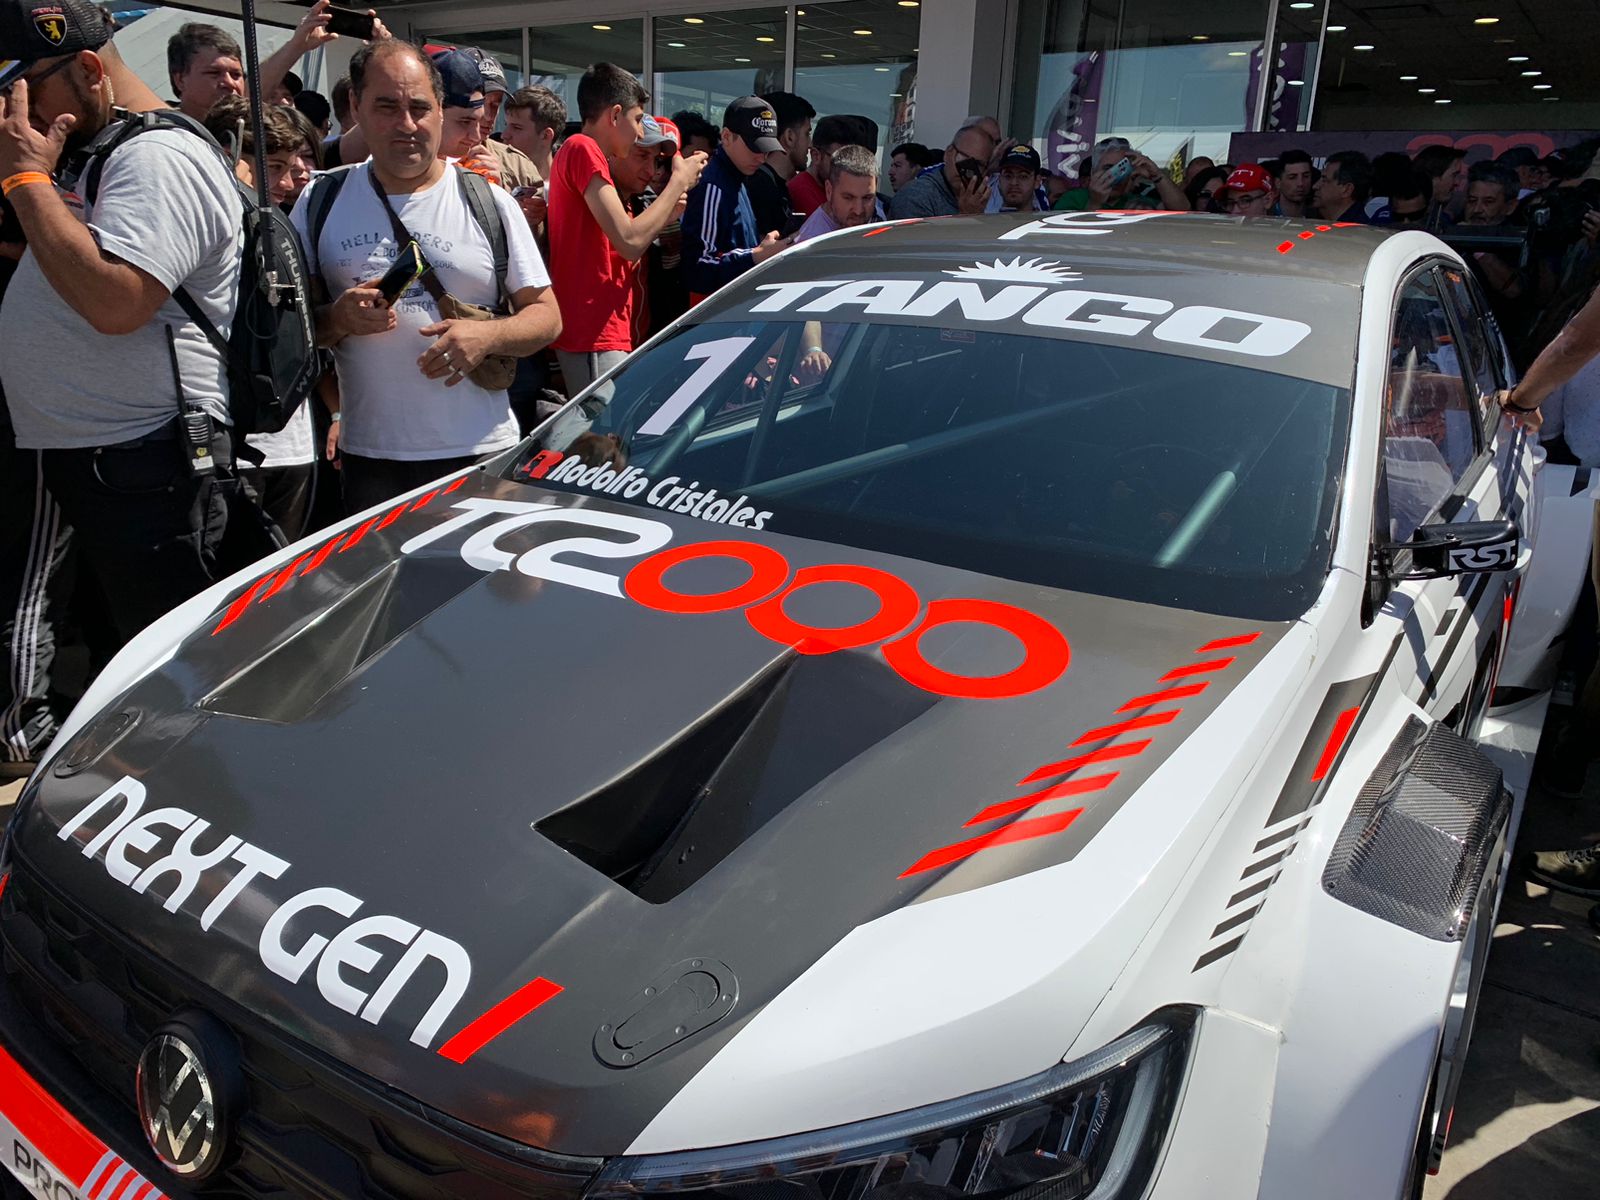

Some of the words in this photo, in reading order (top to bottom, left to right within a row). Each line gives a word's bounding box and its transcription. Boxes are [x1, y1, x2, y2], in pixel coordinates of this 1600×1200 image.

[751, 117, 777, 128] Corona
[340, 232, 382, 252] HELL
[748, 279, 1312, 357] TANGO
[636, 336, 756, 436] 1
[545, 454, 649, 499] Rodolfo
[646, 476, 774, 531] Cristales
[400, 496, 1070, 699] TC2000
[12, 1138, 80, 1200] PRO
